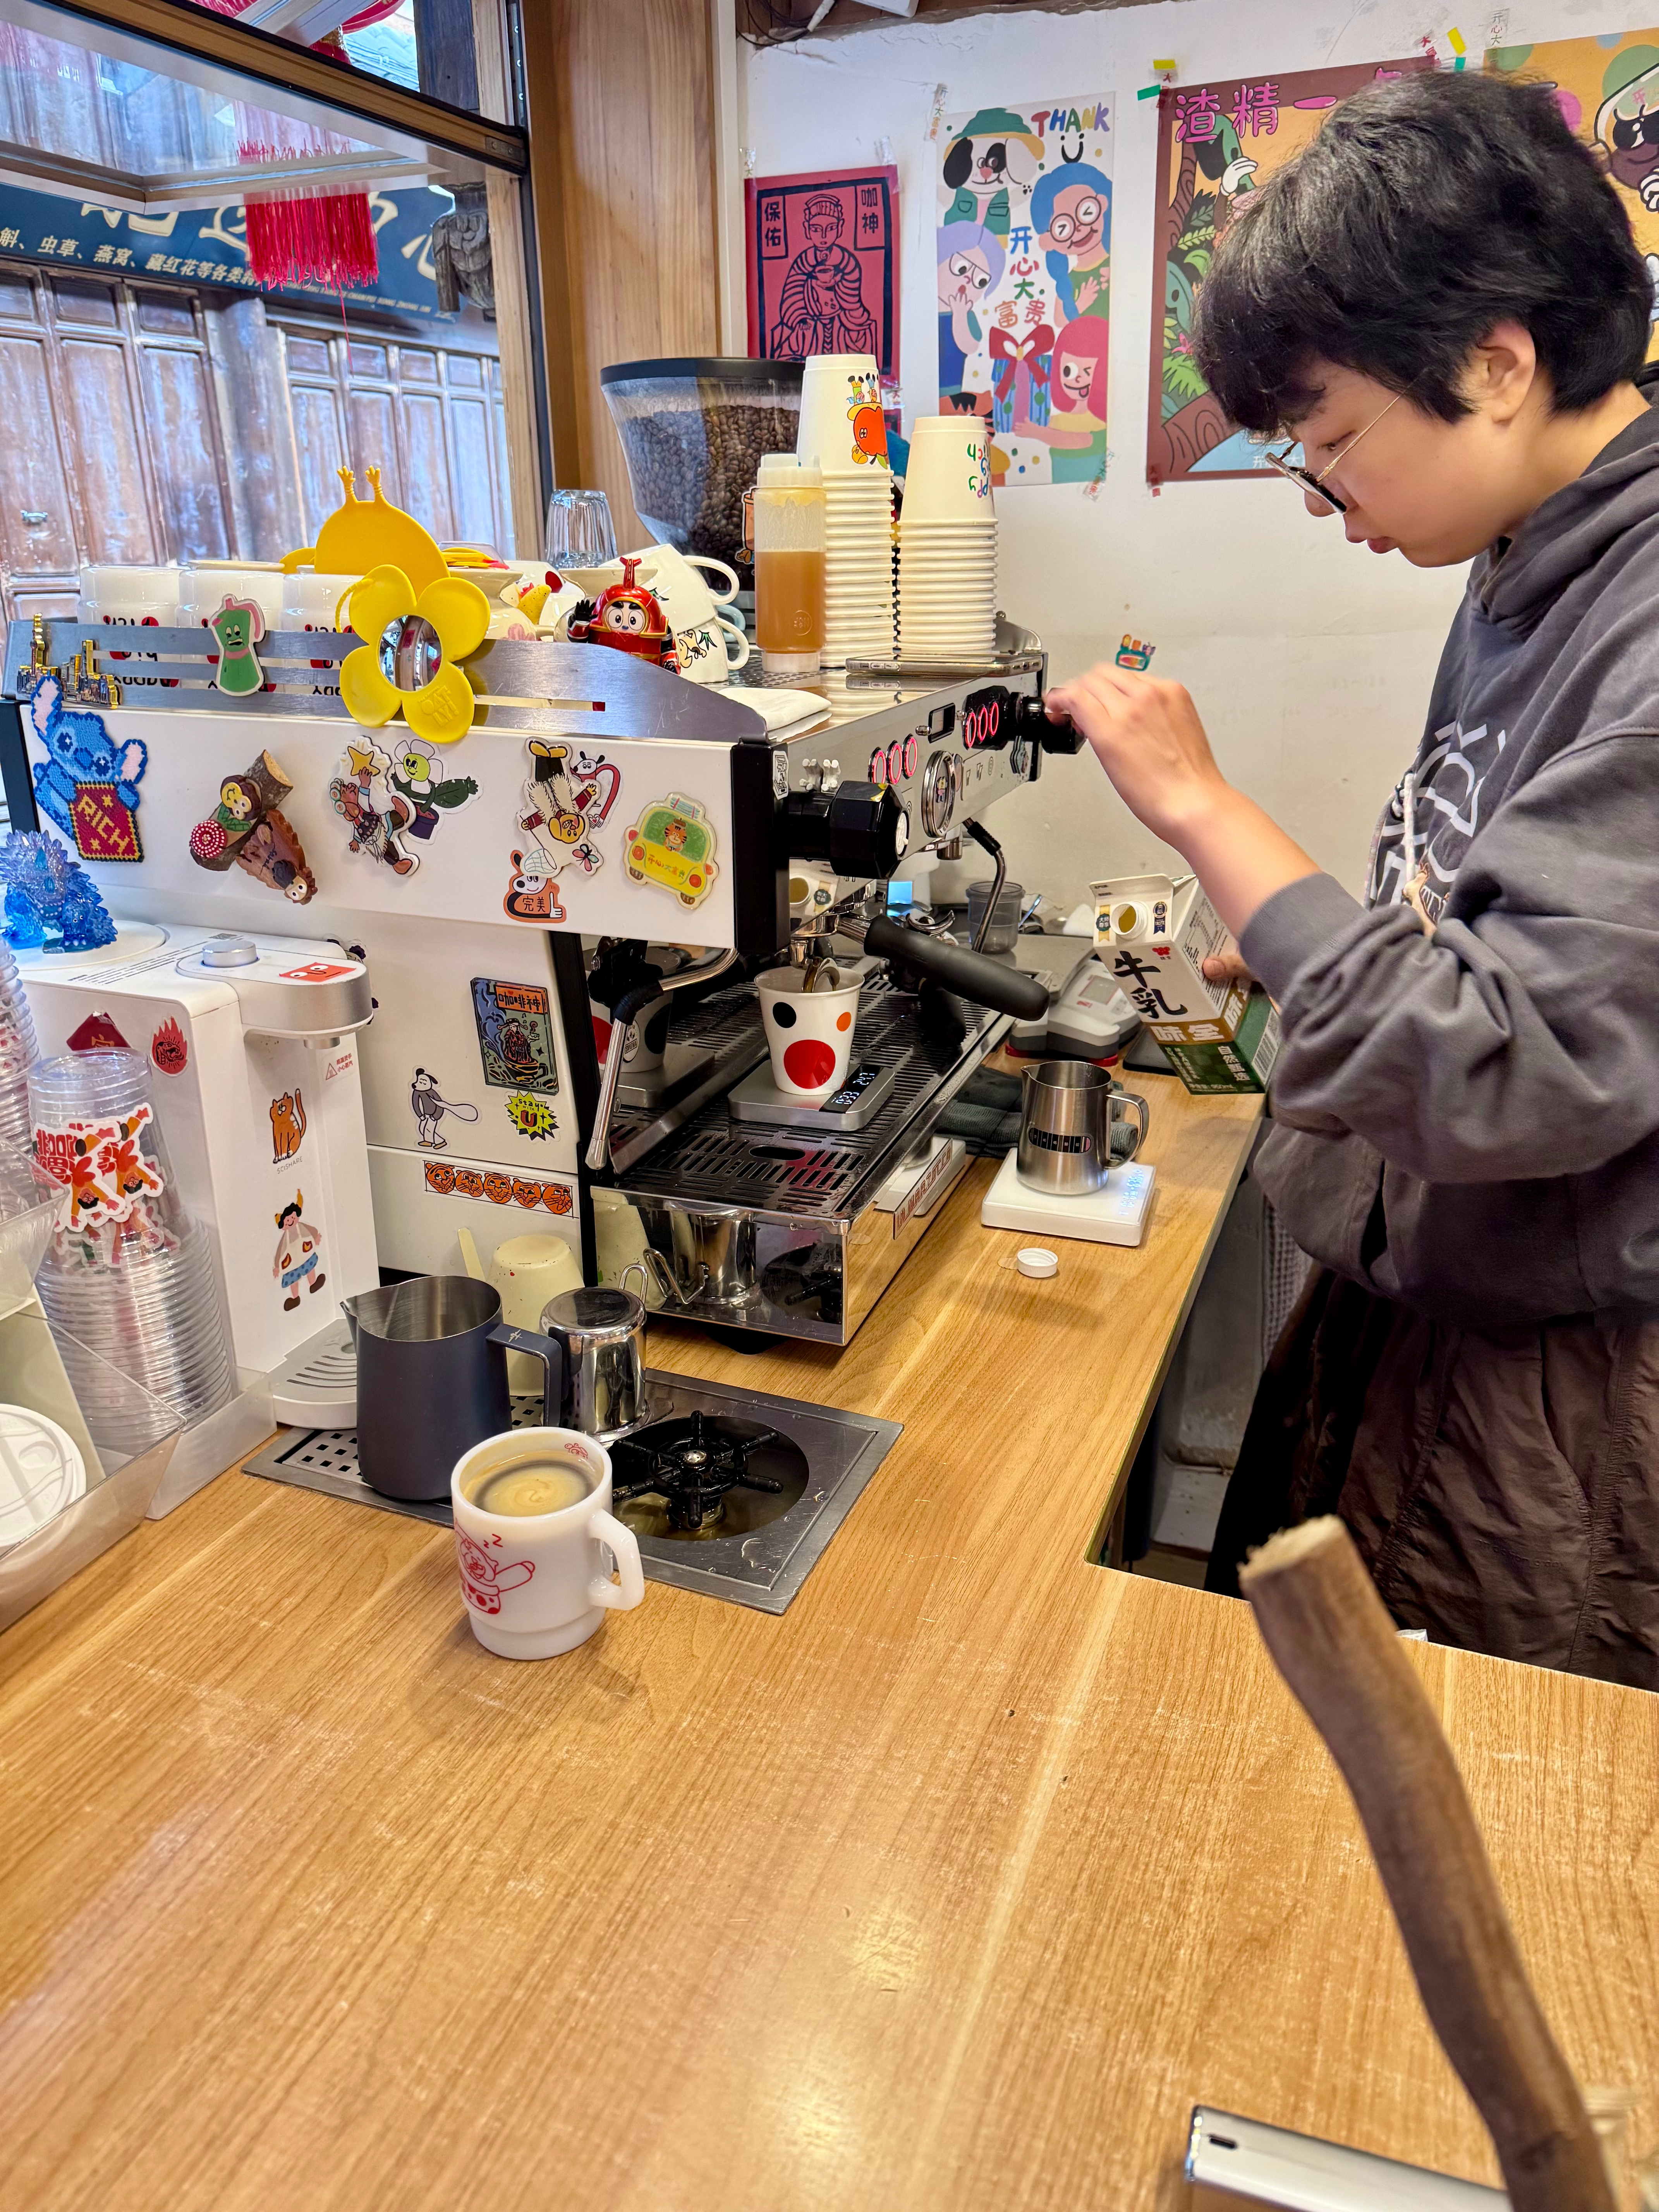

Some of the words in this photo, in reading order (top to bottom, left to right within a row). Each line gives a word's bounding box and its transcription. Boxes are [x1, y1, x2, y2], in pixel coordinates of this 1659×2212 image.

[1031, 102, 1110, 137] THANK
[861, 187, 878, 234] 咖神
[764, 202, 781, 247] 保佑
[969, 476, 989, 498] ppy
[77, 794, 131, 856] RICH
[522, 895, 546, 913] 完美
[1114, 950, 1188, 1020] 牛乳
[498, 991, 541, 1012] 咖啡神
[1150, 1024, 1224, 1042] 味全
[519, 1099, 540, 1112] stay
[520, 1110, 538, 1128] U
[277, 1156, 302, 1174] SCISHARE
